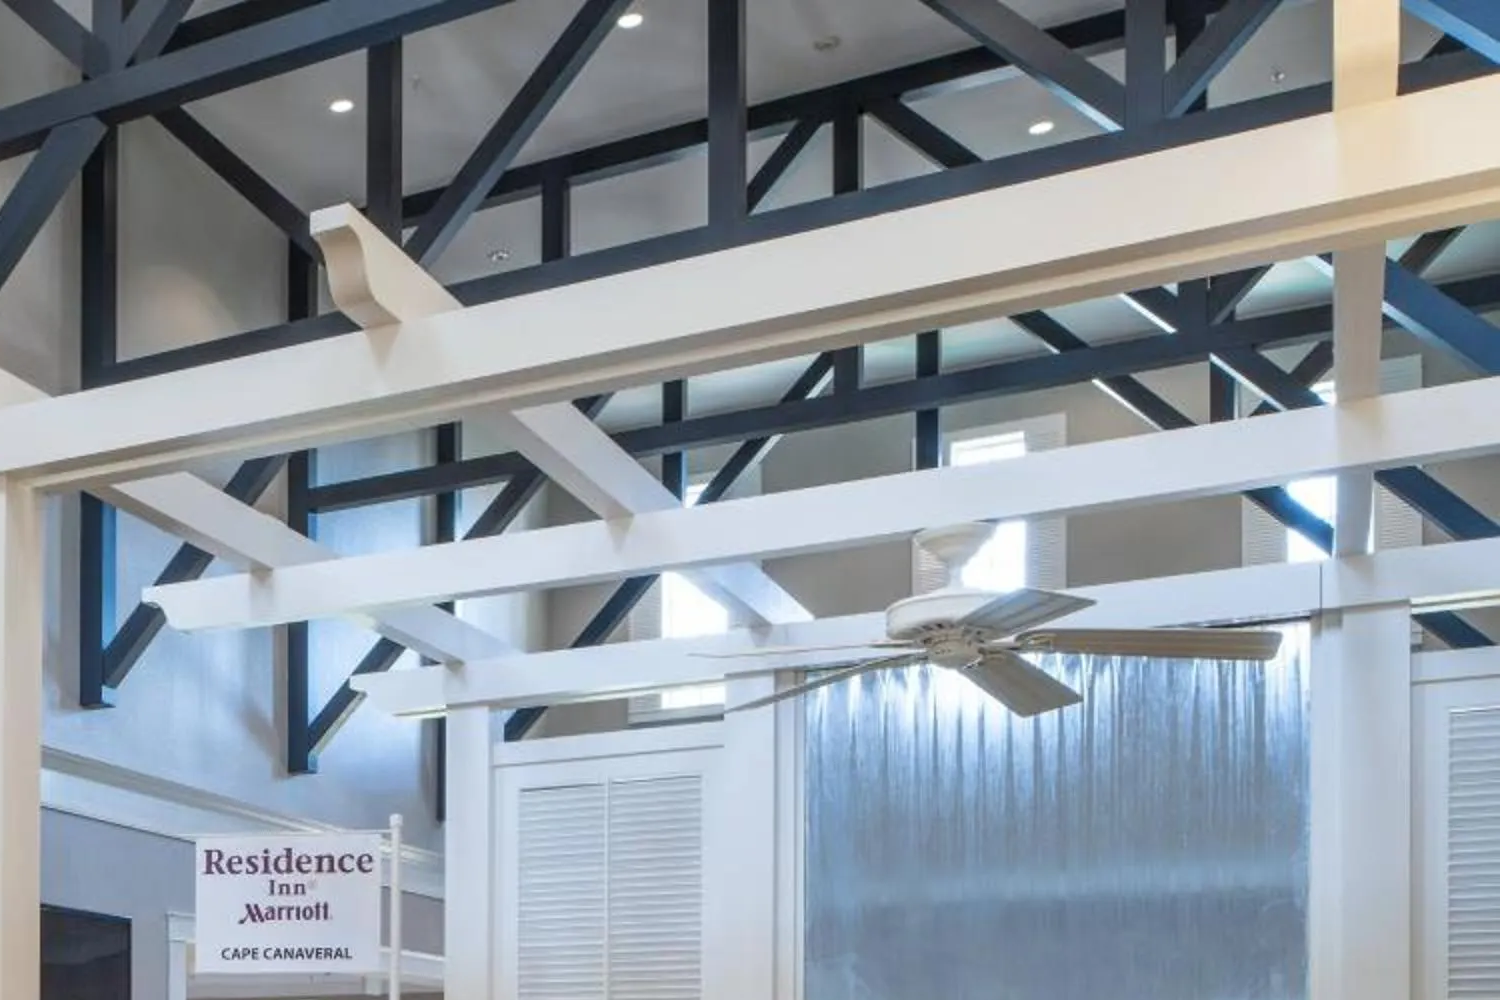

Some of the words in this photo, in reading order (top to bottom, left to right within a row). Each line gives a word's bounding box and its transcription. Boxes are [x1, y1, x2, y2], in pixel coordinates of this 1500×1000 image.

[203, 848, 373, 875] Residence
[269, 880, 306, 896] Inn
[238, 902, 329, 924] Marriott
[221, 947, 258, 961] CAPE
[263, 947, 353, 960] CANAVERAL
